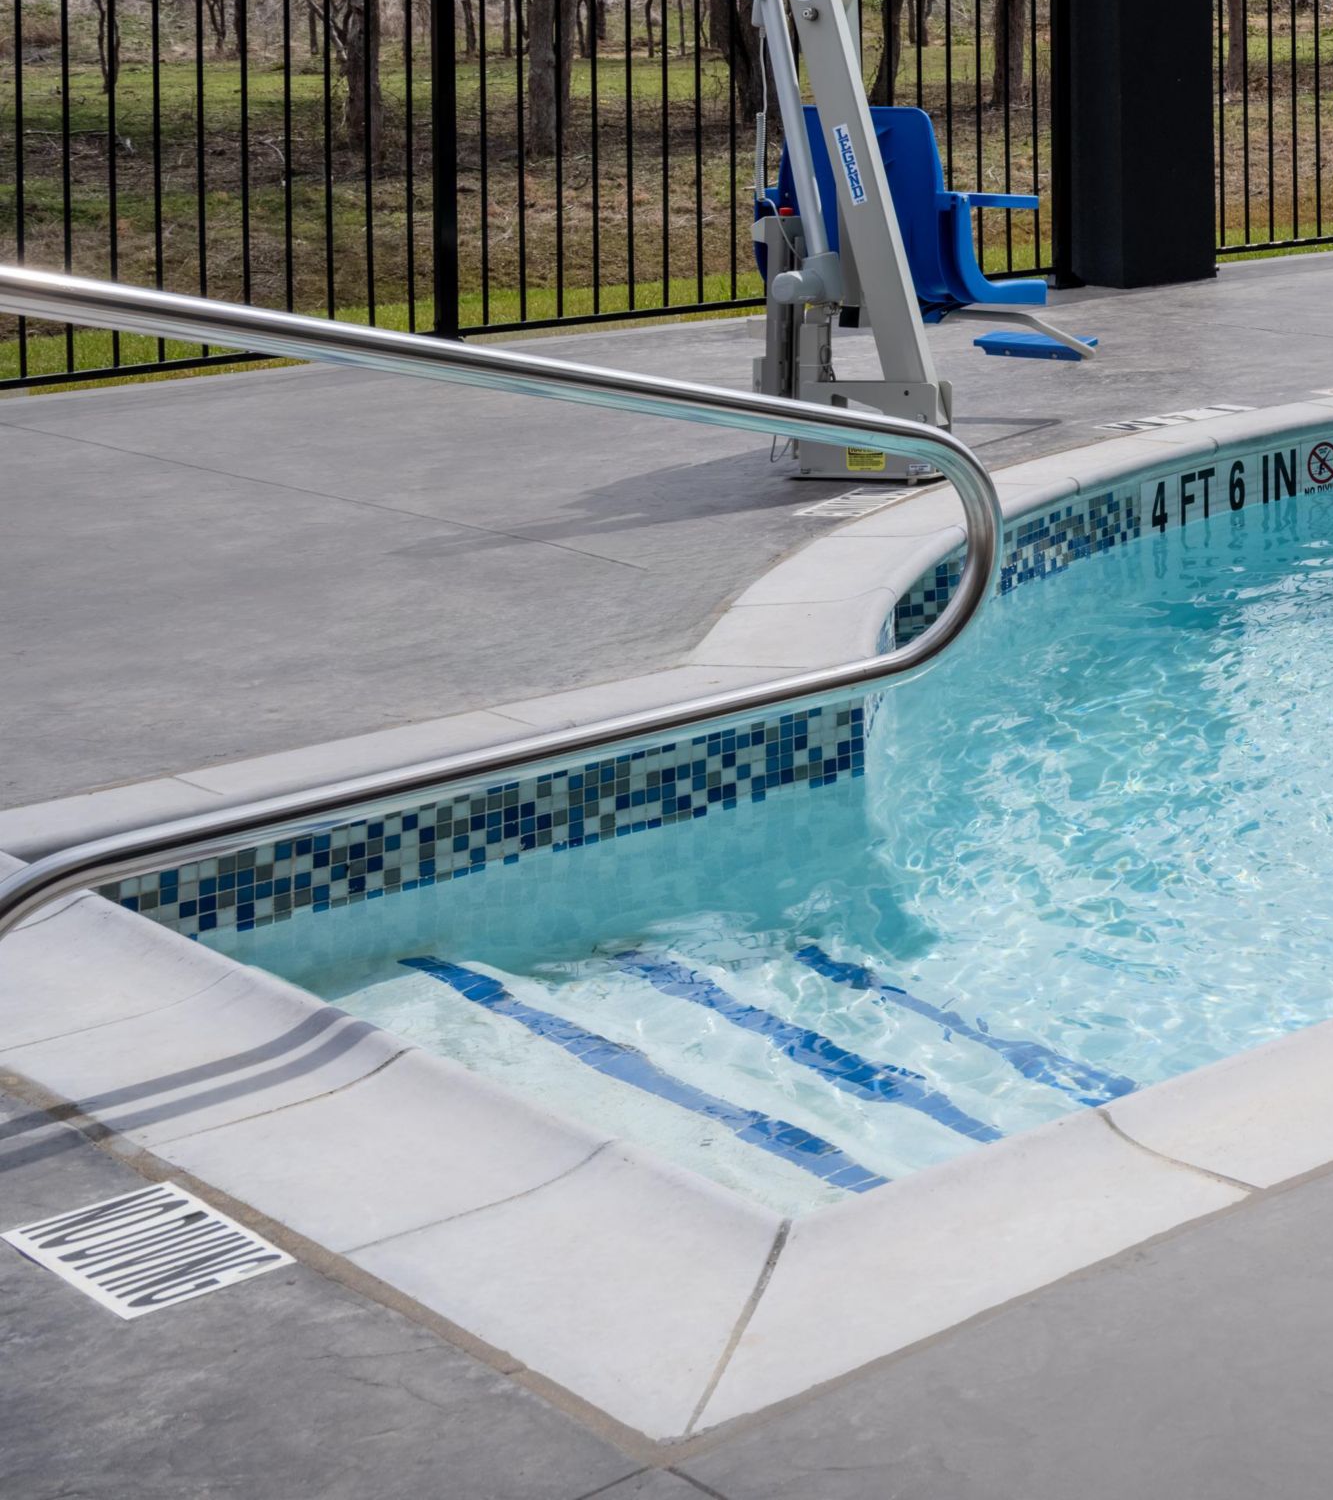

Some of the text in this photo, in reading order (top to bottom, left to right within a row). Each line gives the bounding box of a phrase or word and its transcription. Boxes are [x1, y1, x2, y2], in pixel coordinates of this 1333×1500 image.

[835, 127, 864, 199] LEGEND
[1152, 481, 1168, 533] 4
[1180, 466, 1216, 526] FT
[1228, 459, 1246, 511] 6
[1262, 448, 1298, 503] IN
[20, 1186, 282, 1308] NO DIVING
